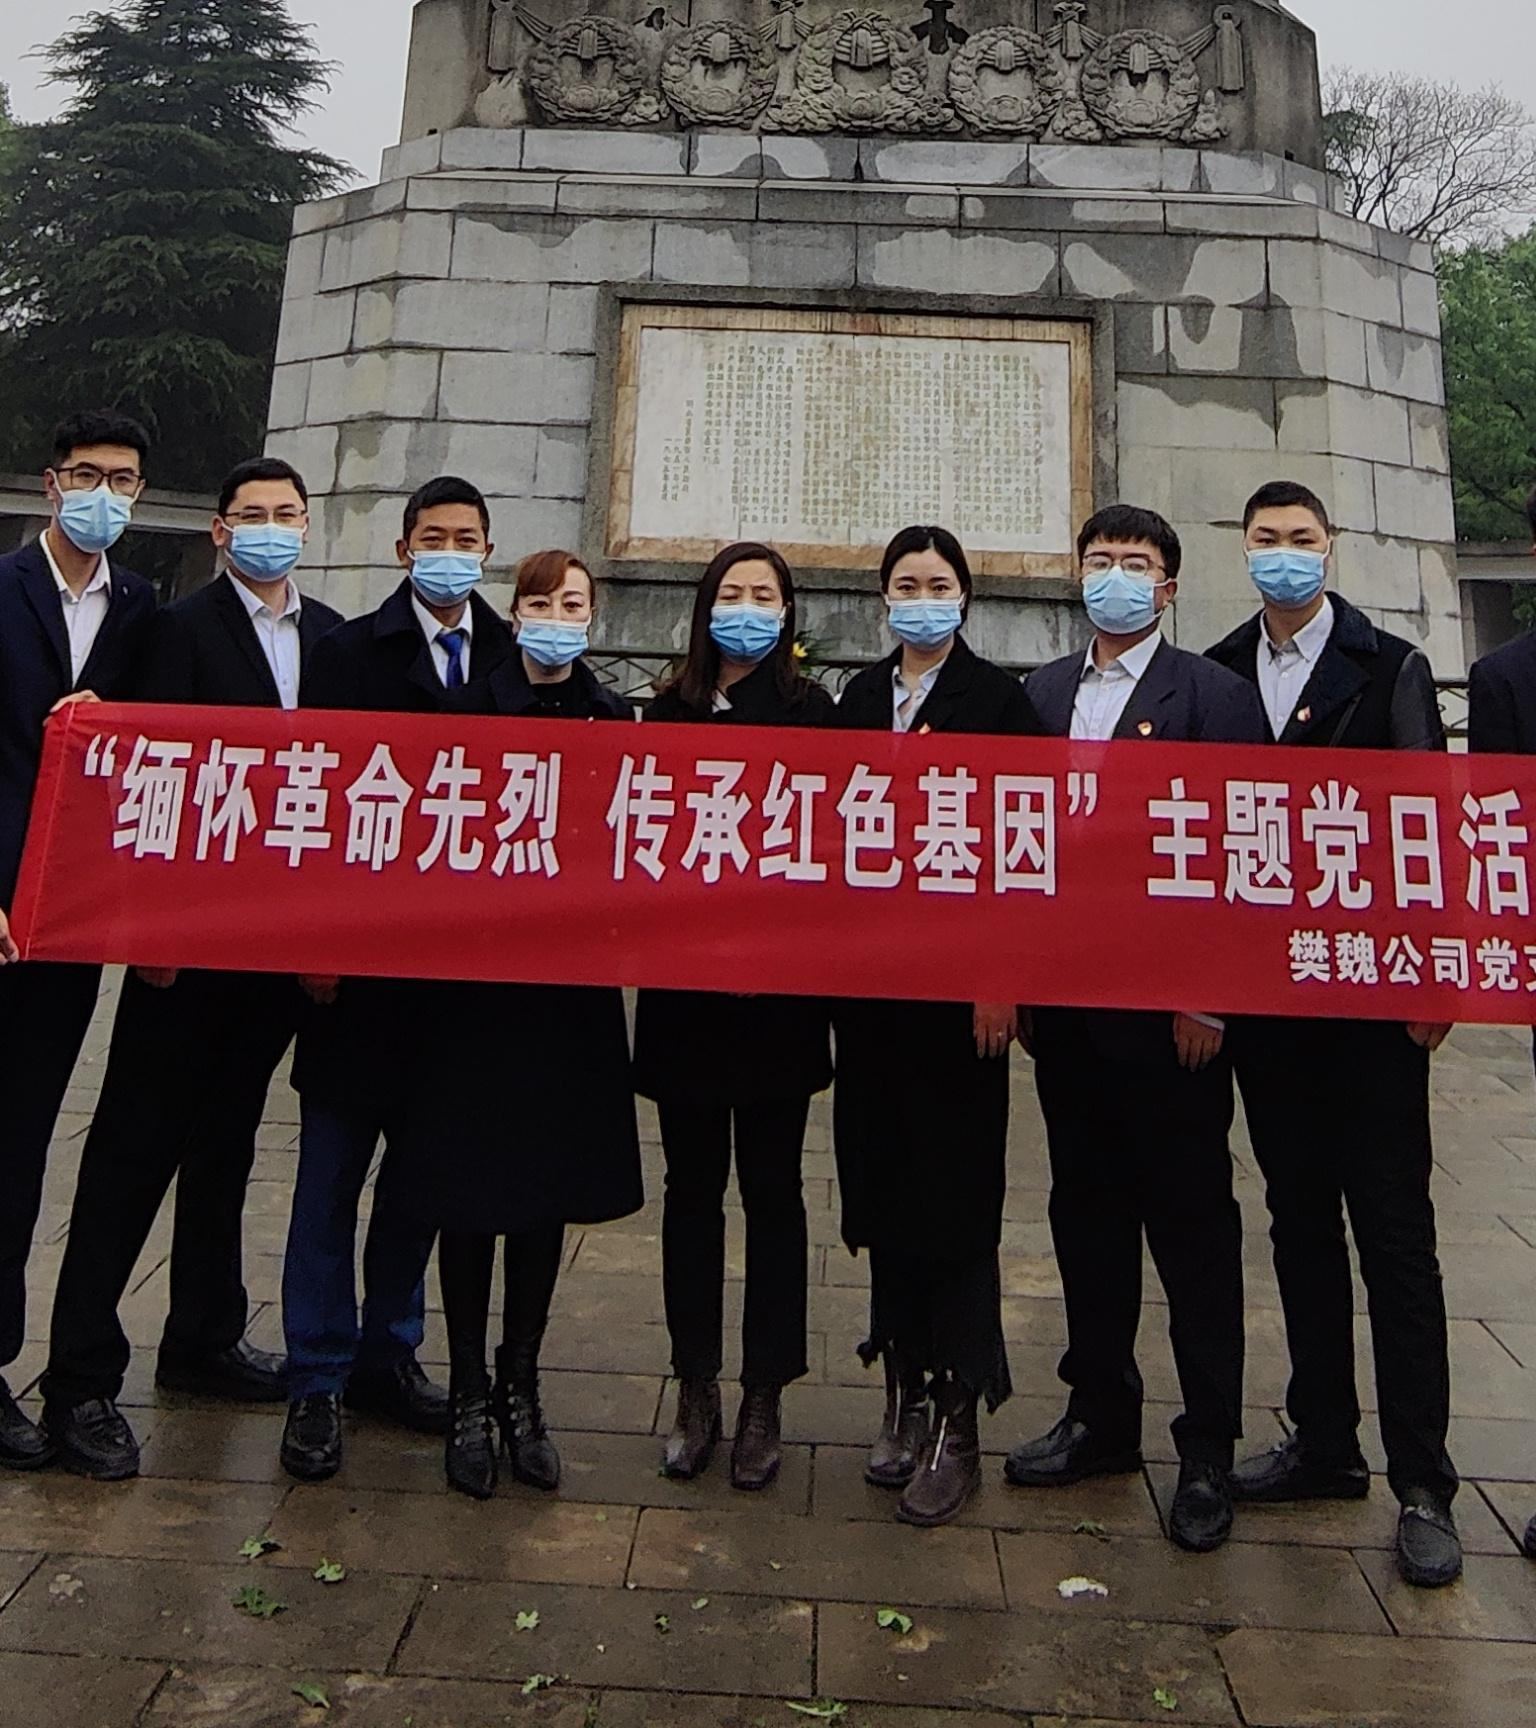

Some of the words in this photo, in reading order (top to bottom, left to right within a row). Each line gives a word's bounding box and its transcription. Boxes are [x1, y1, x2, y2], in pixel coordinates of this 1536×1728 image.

[84, 733, 563, 878] “缅怀革命先烈
[605, 754, 1099, 897] 传承红色基因”
